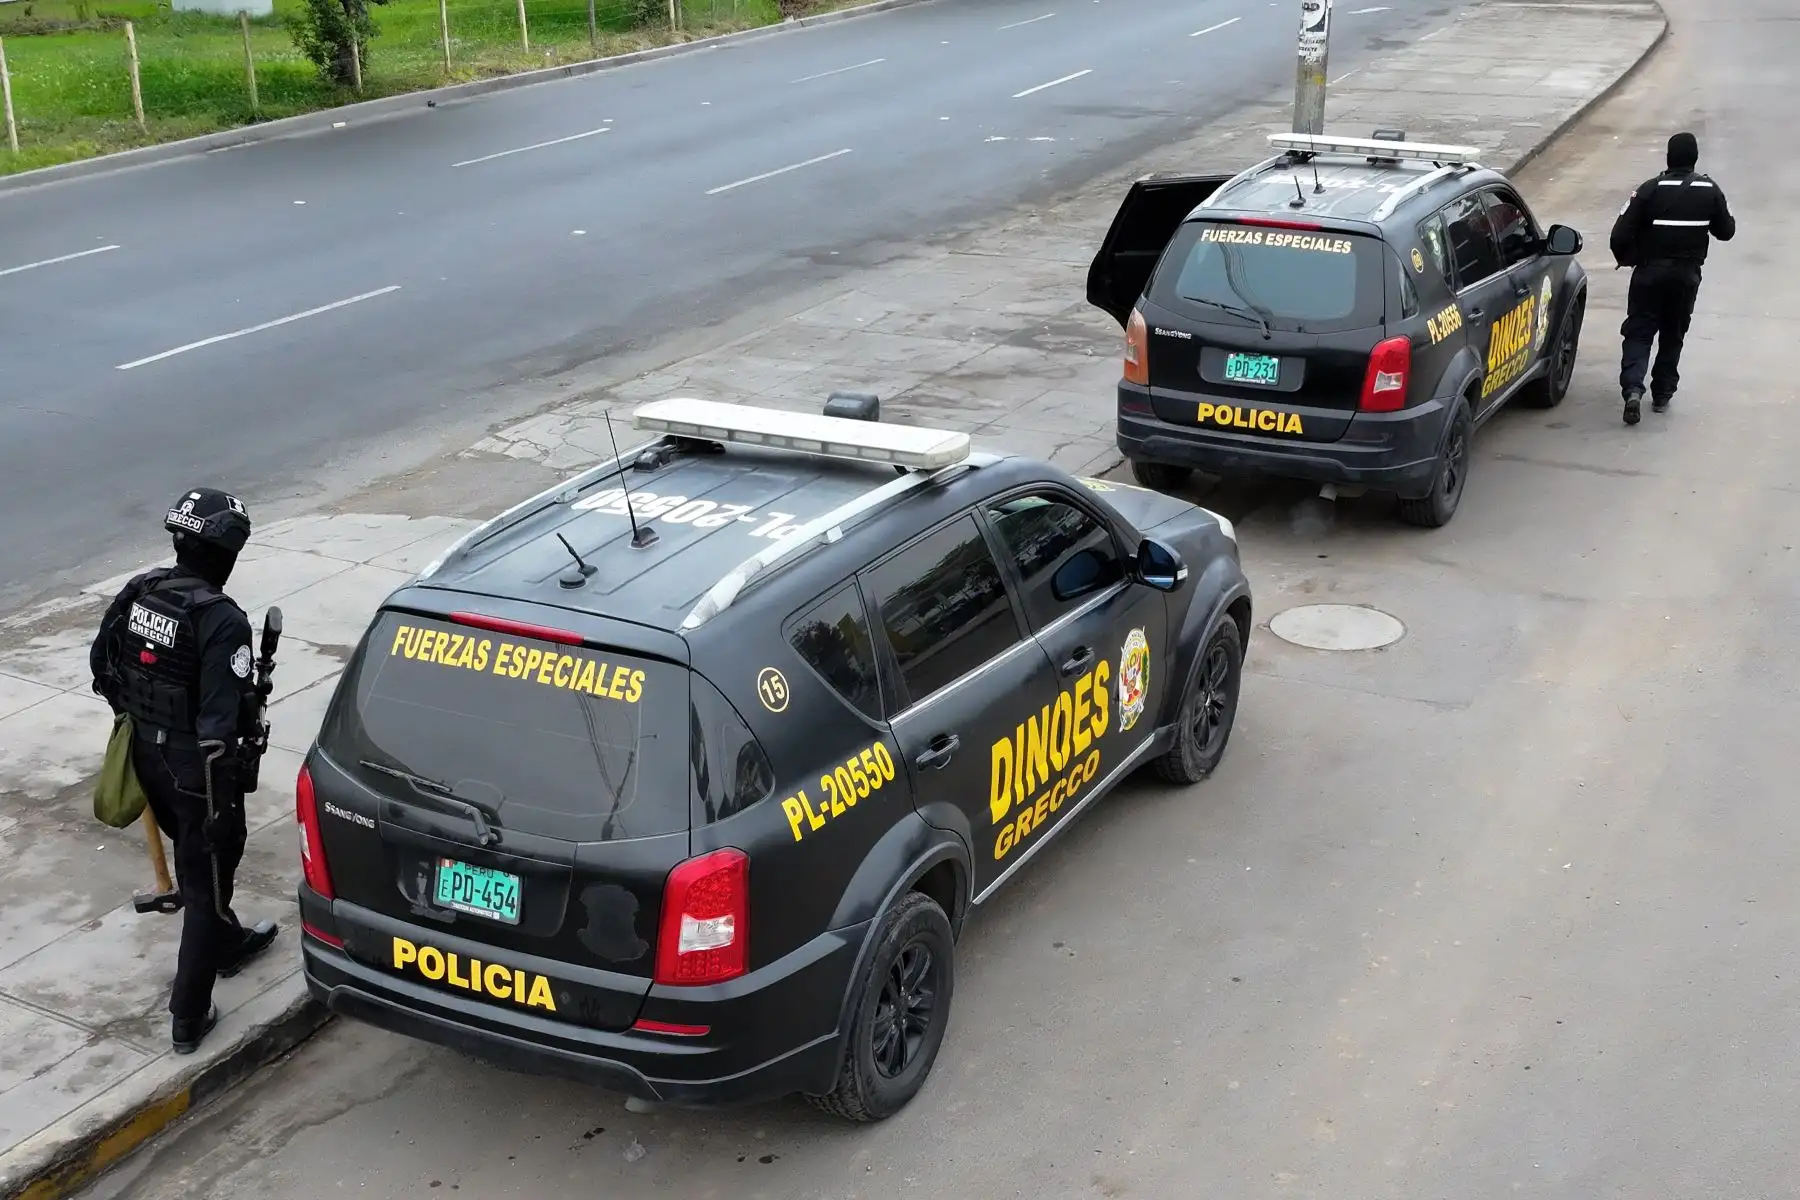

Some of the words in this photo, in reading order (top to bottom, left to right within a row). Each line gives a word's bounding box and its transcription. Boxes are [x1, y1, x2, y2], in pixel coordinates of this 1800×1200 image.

[1201, 229, 1262, 245] FUERZAS
[1265, 233, 1353, 255] ESPECIALES
[1488, 295, 1535, 375] DINOES
[1481, 349, 1529, 399] GRECCO
[1197, 402, 1304, 435] POLICIA
[131, 604, 173, 638] POLICIA
[131, 621, 171, 645] GRECCO
[391, 625, 492, 672] FUERZAS
[493, 643, 646, 704] ESPECIALES
[761, 674, 785, 704] 15
[989, 659, 1111, 826] DINOES
[781, 741, 896, 843] PL-20550
[994, 749, 1100, 861] GRECCO
[393, 936, 557, 1012] POLICIA
